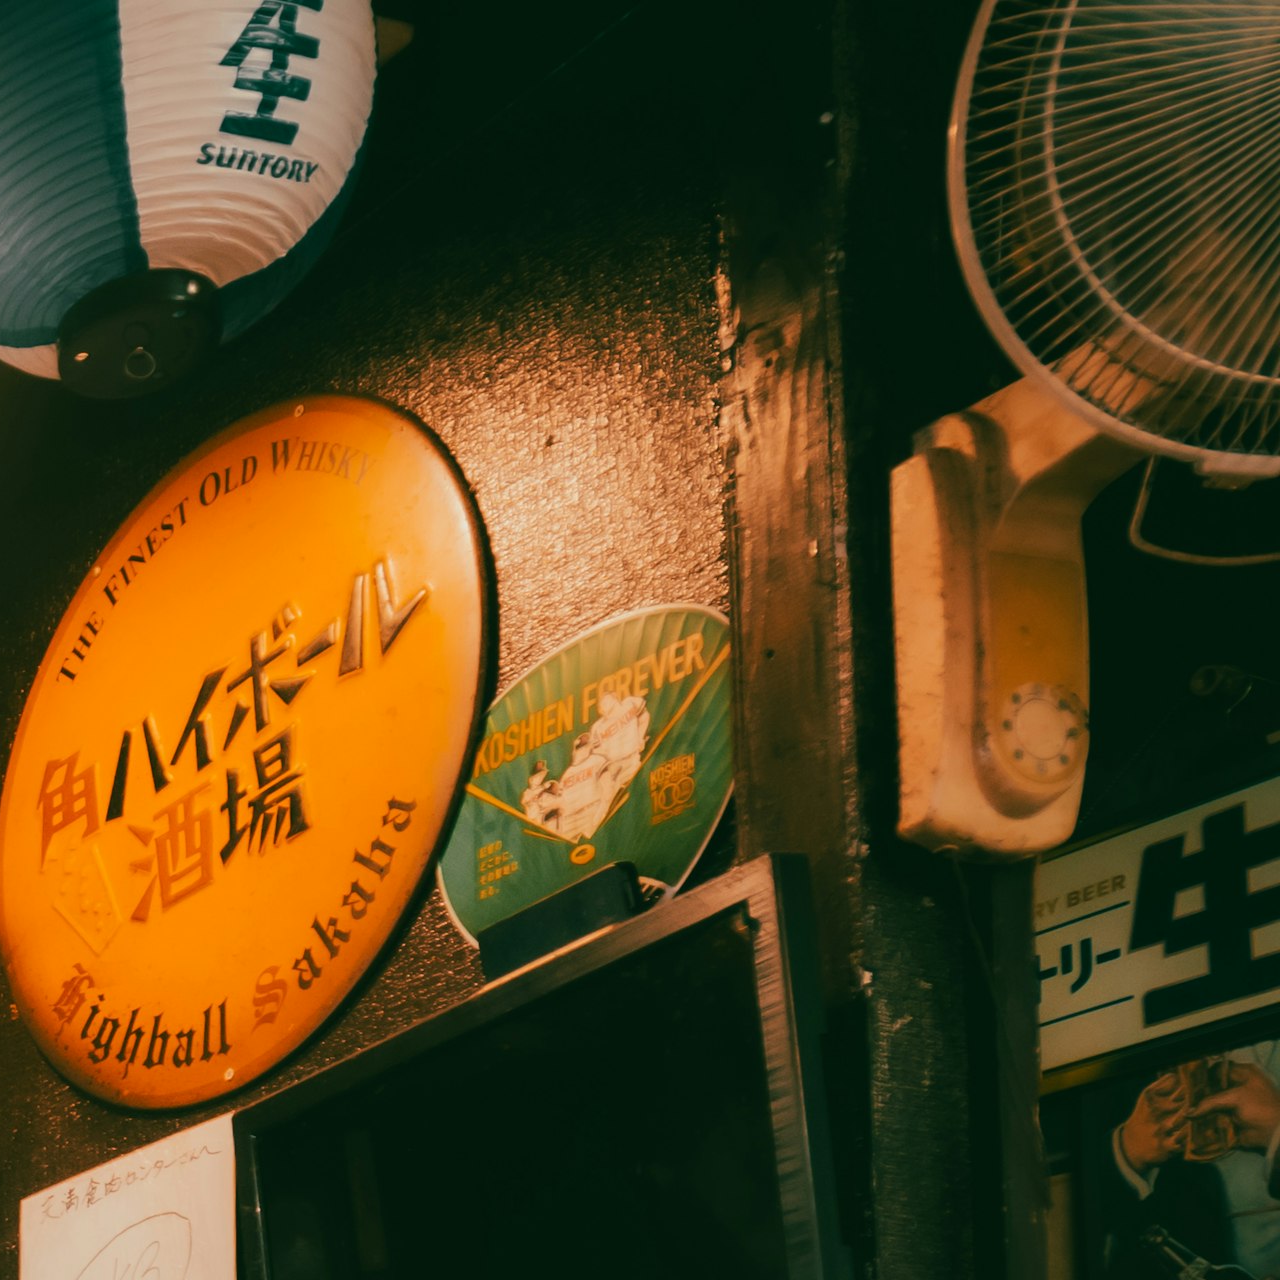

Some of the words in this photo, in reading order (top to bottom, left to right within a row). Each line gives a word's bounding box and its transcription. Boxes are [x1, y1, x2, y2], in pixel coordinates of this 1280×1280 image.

[195, 141, 321, 184] SUNTORY
[56, 614, 105, 684] THE
[103, 496, 190, 604] FINEST
[197, 455, 258, 507] OLD
[268, 437, 375, 487] WHISKY
[39, 557, 432, 870] 角ハイボール
[473, 694, 575, 778] KOSHIEN
[581, 632, 706, 725] FOREVER
[128, 721, 313, 923] 酒場
[250, 794, 418, 1030] Sakaba
